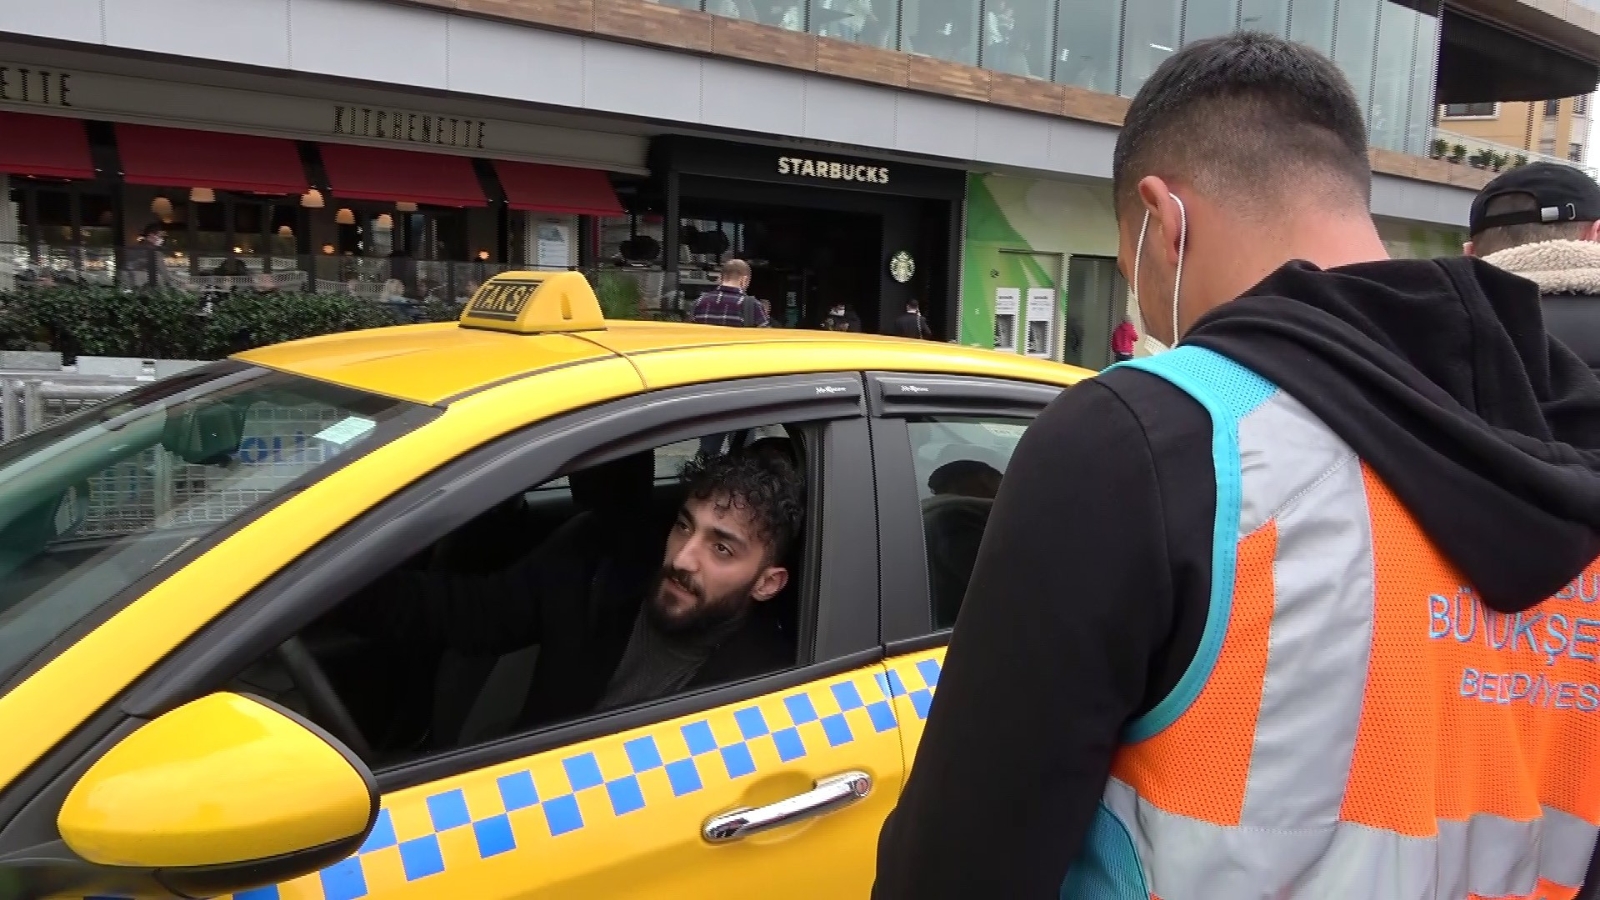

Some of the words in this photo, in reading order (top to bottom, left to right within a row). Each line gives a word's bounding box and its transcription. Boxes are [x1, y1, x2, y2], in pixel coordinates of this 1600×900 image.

[0, 67, 72, 106] ETTE
[334, 106, 485, 148] KITCHENETTE
[778, 157, 889, 184] STARBUCKS
